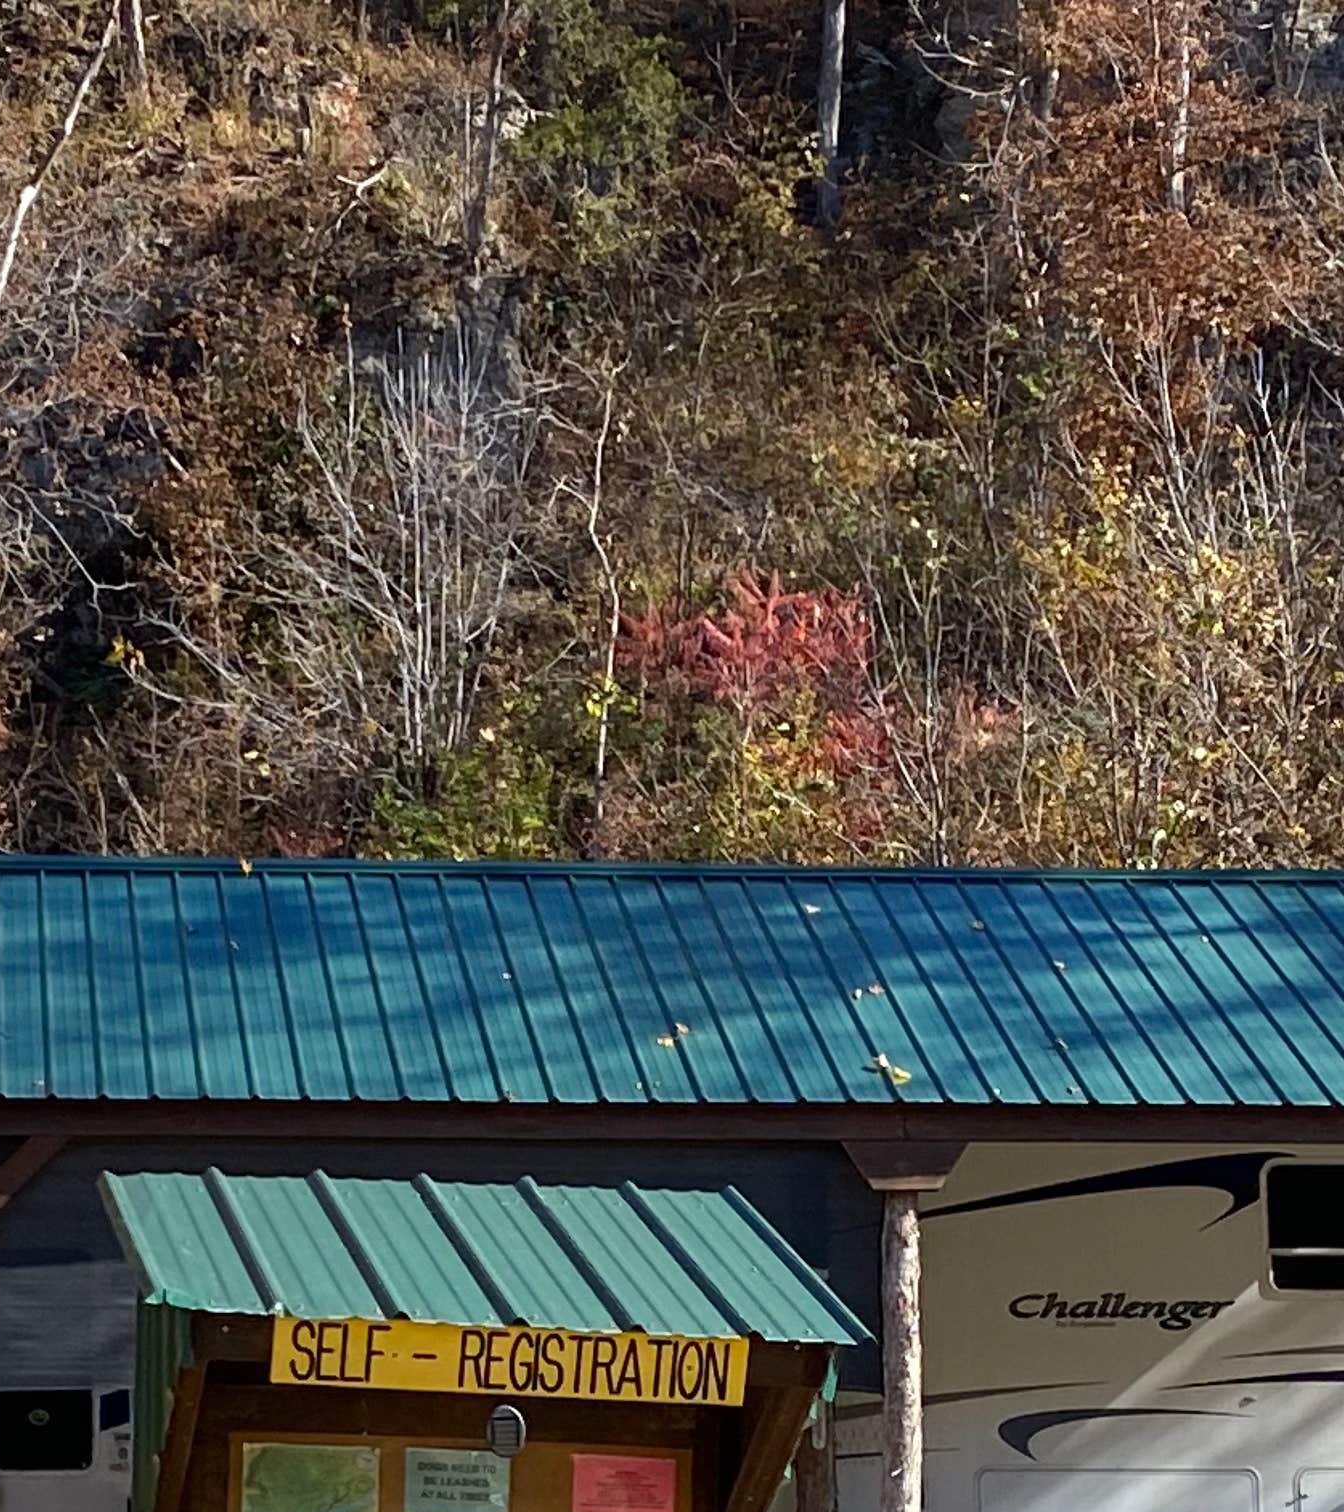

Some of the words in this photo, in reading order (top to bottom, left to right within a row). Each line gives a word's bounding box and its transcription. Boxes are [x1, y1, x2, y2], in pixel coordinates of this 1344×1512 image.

[1009, 1292, 1236, 1331] Challenger
[289, 1320, 392, 1383] SELF
[458, 1328, 731, 1400] REGISTRATION
